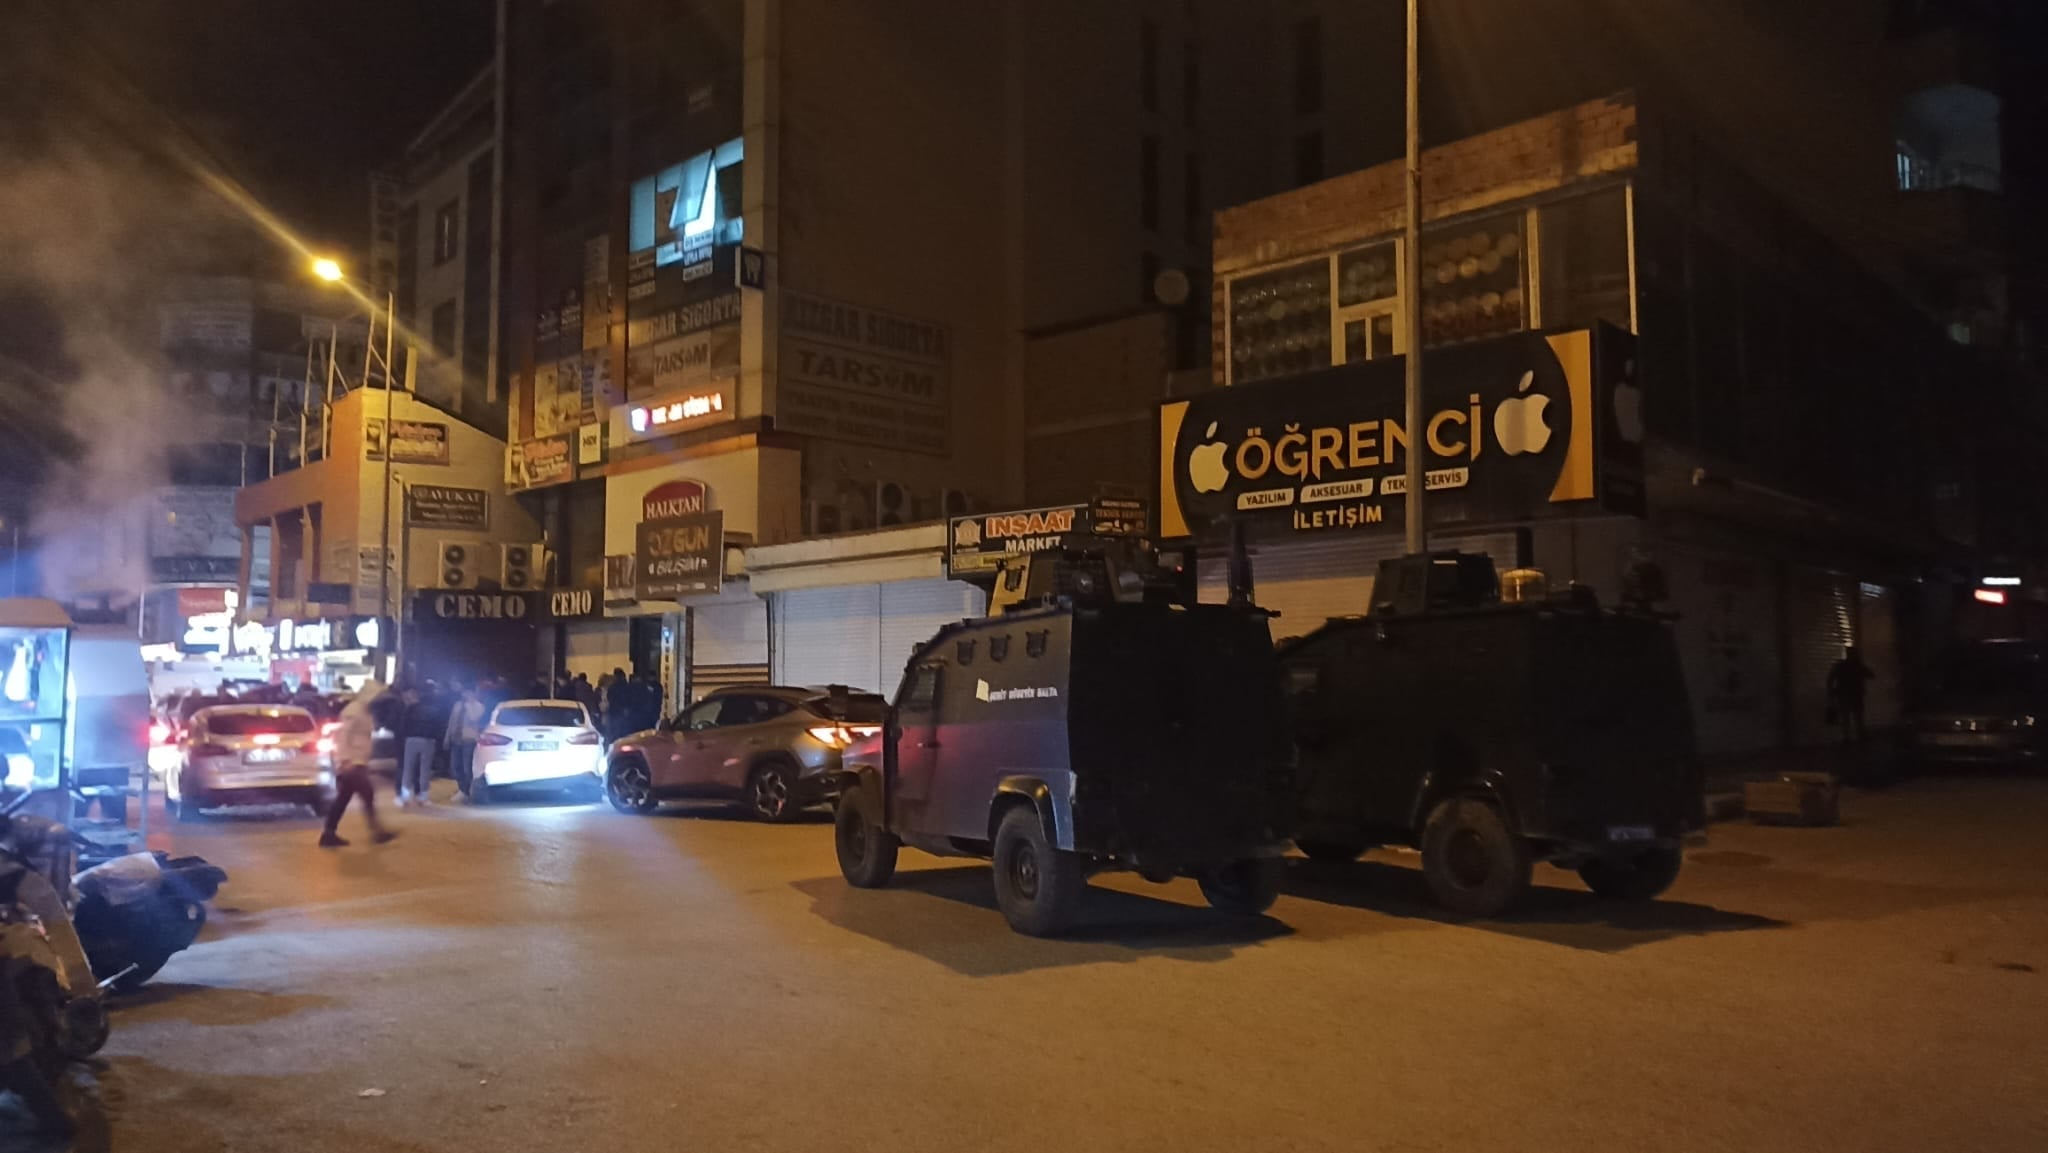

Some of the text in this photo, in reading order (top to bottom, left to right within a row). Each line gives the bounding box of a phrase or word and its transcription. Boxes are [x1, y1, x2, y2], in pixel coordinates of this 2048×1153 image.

[1236, 393, 1481, 481] ÖĞRENCİ
[1245, 492, 1286, 506] YAZILIM
[1310, 483, 1363, 498] AKSESUAR
[1387, 479, 1406, 490] TEK
[1294, 502, 1382, 529] İLETİŞİM
[435, 593, 526, 619] CEMO
[551, 589, 593, 616] CEMO
